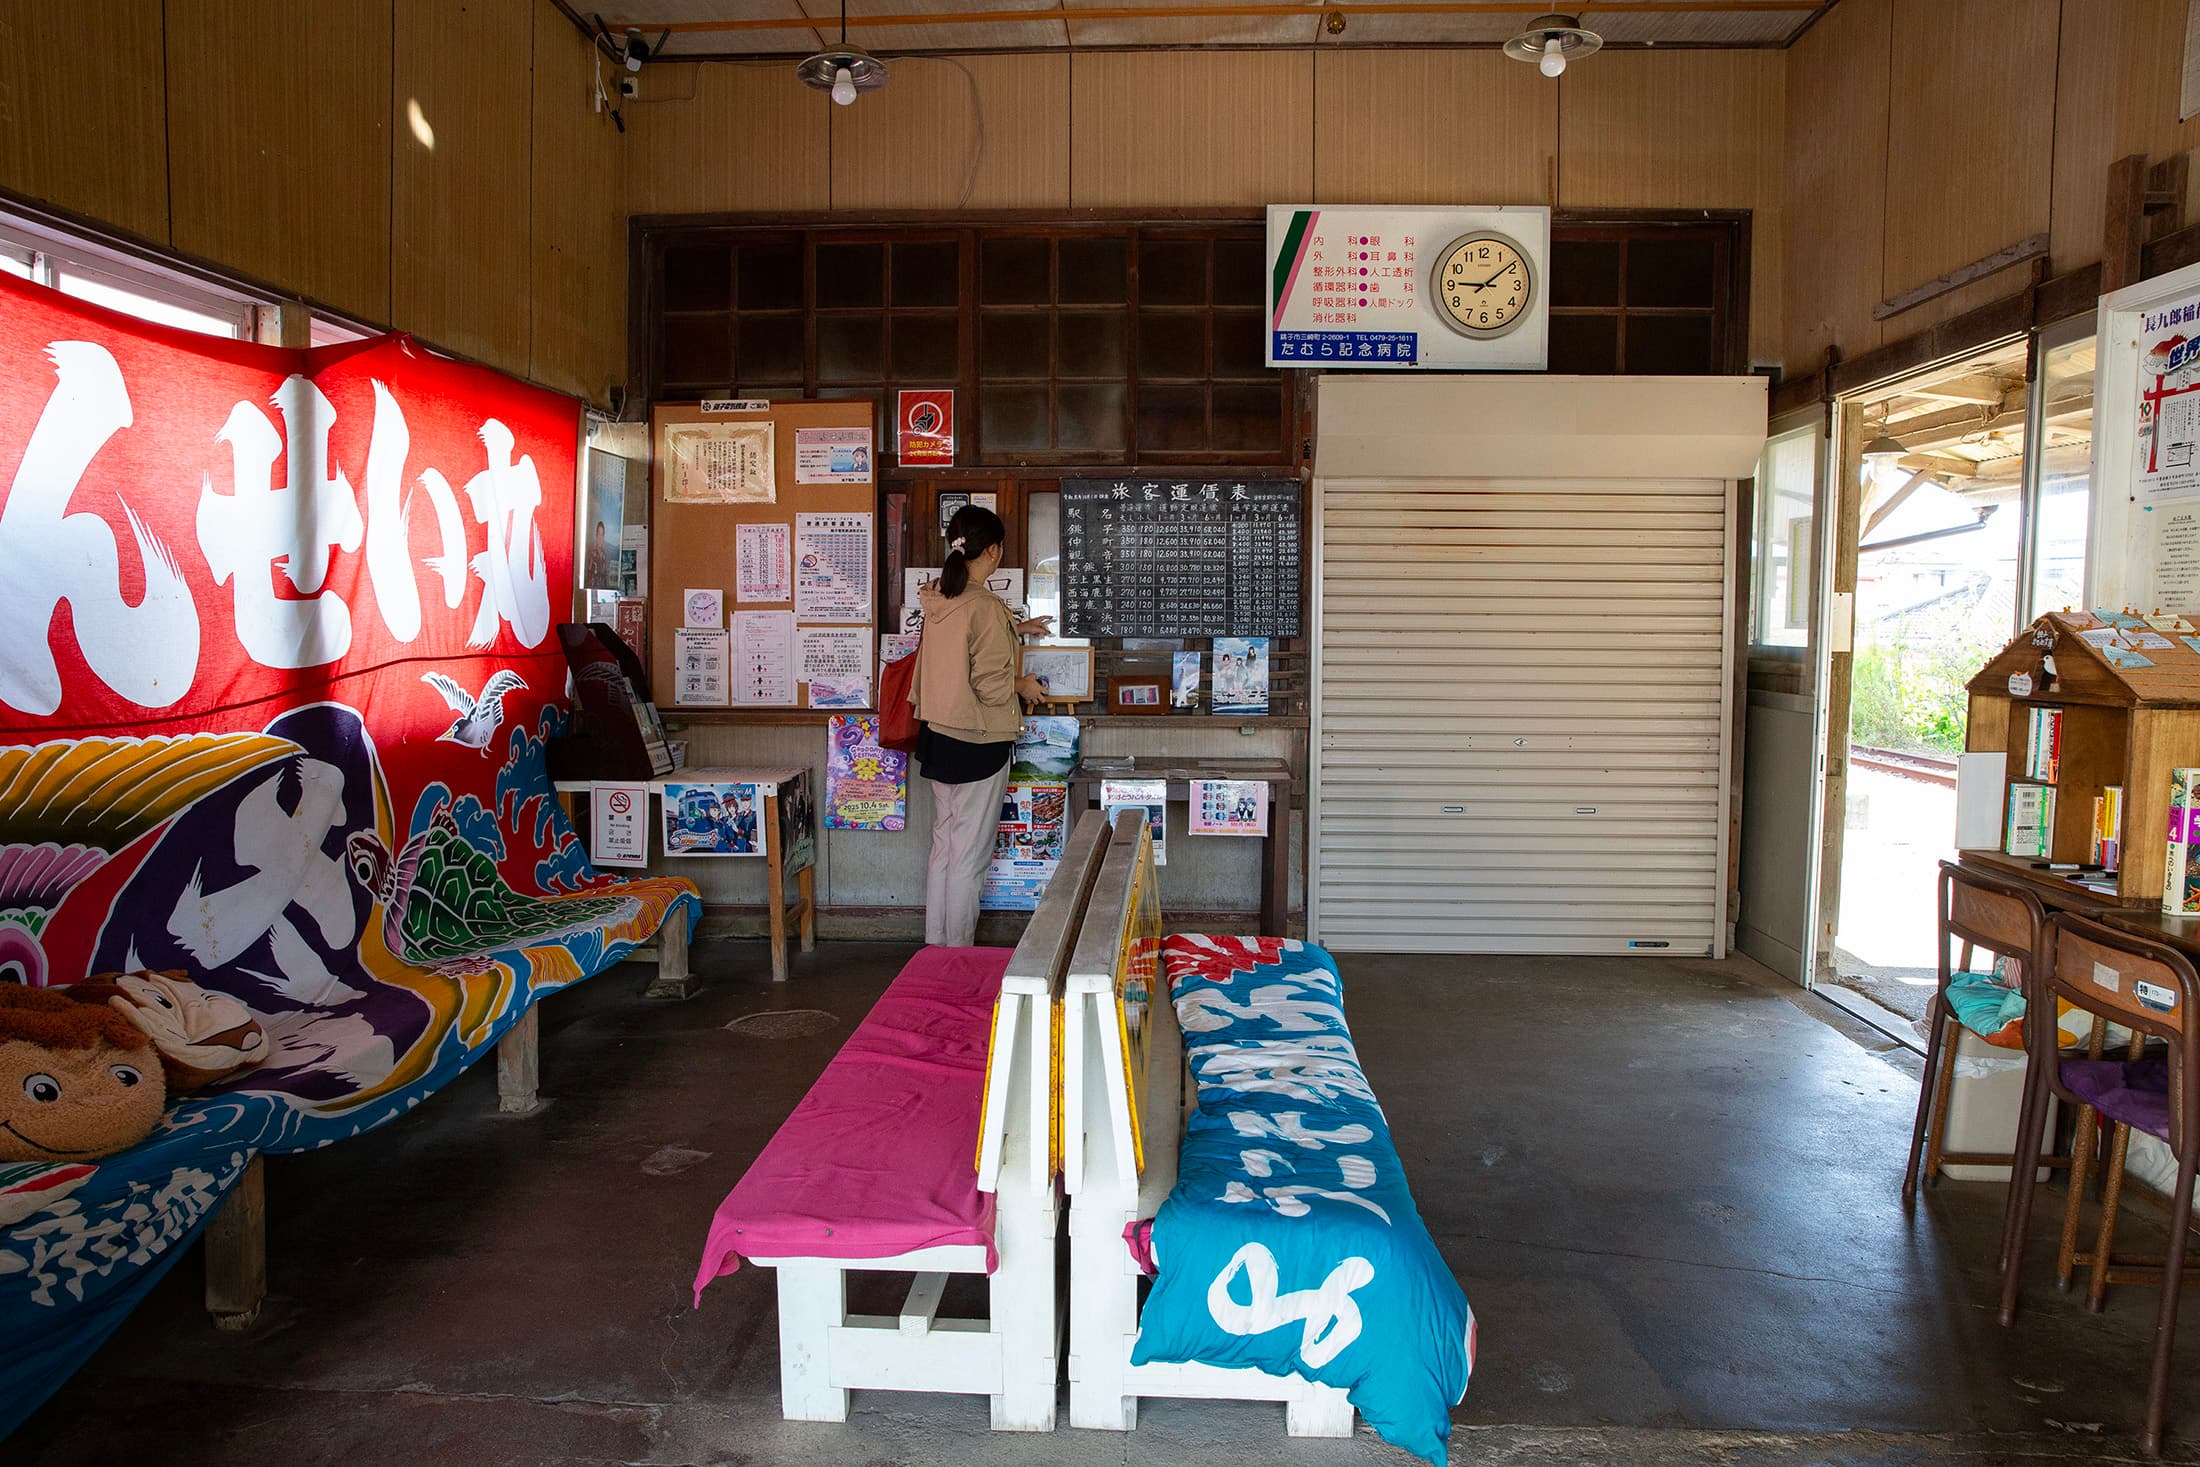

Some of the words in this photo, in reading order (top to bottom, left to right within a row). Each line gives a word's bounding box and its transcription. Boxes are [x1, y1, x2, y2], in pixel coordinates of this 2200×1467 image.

[1464, 251, 1473, 262] 11
[1479, 248, 1490, 259] 12
[1498, 251, 1502, 262] 1
[1312, 266, 1358, 277] 整形外科
[1370, 267, 1414, 278] 人工透析
[1452, 264, 1463, 274] 10
[1508, 263, 1517, 274] 2
[1312, 282, 1357, 292] 循環器科
[1447, 280, 1455, 291] 9
[1513, 280, 1521, 291] 3
[1312, 297, 1357, 308] 呼吸器科
[1370, 298, 1414, 308] 人間ドック
[1452, 296, 1460, 307] 8
[1508, 296, 1515, 307] 4
[1312, 312, 1357, 324] 消化器科
[1466, 308, 1473, 319] 7
[1480, 312, 1488, 323] 6
[1496, 308, 1504, 320] 5
[1281, 342, 1411, 357] たむら記念病院
[1112, 482, 1250, 502] 旅客運賃表
[2169, 826, 2177, 840] 4
